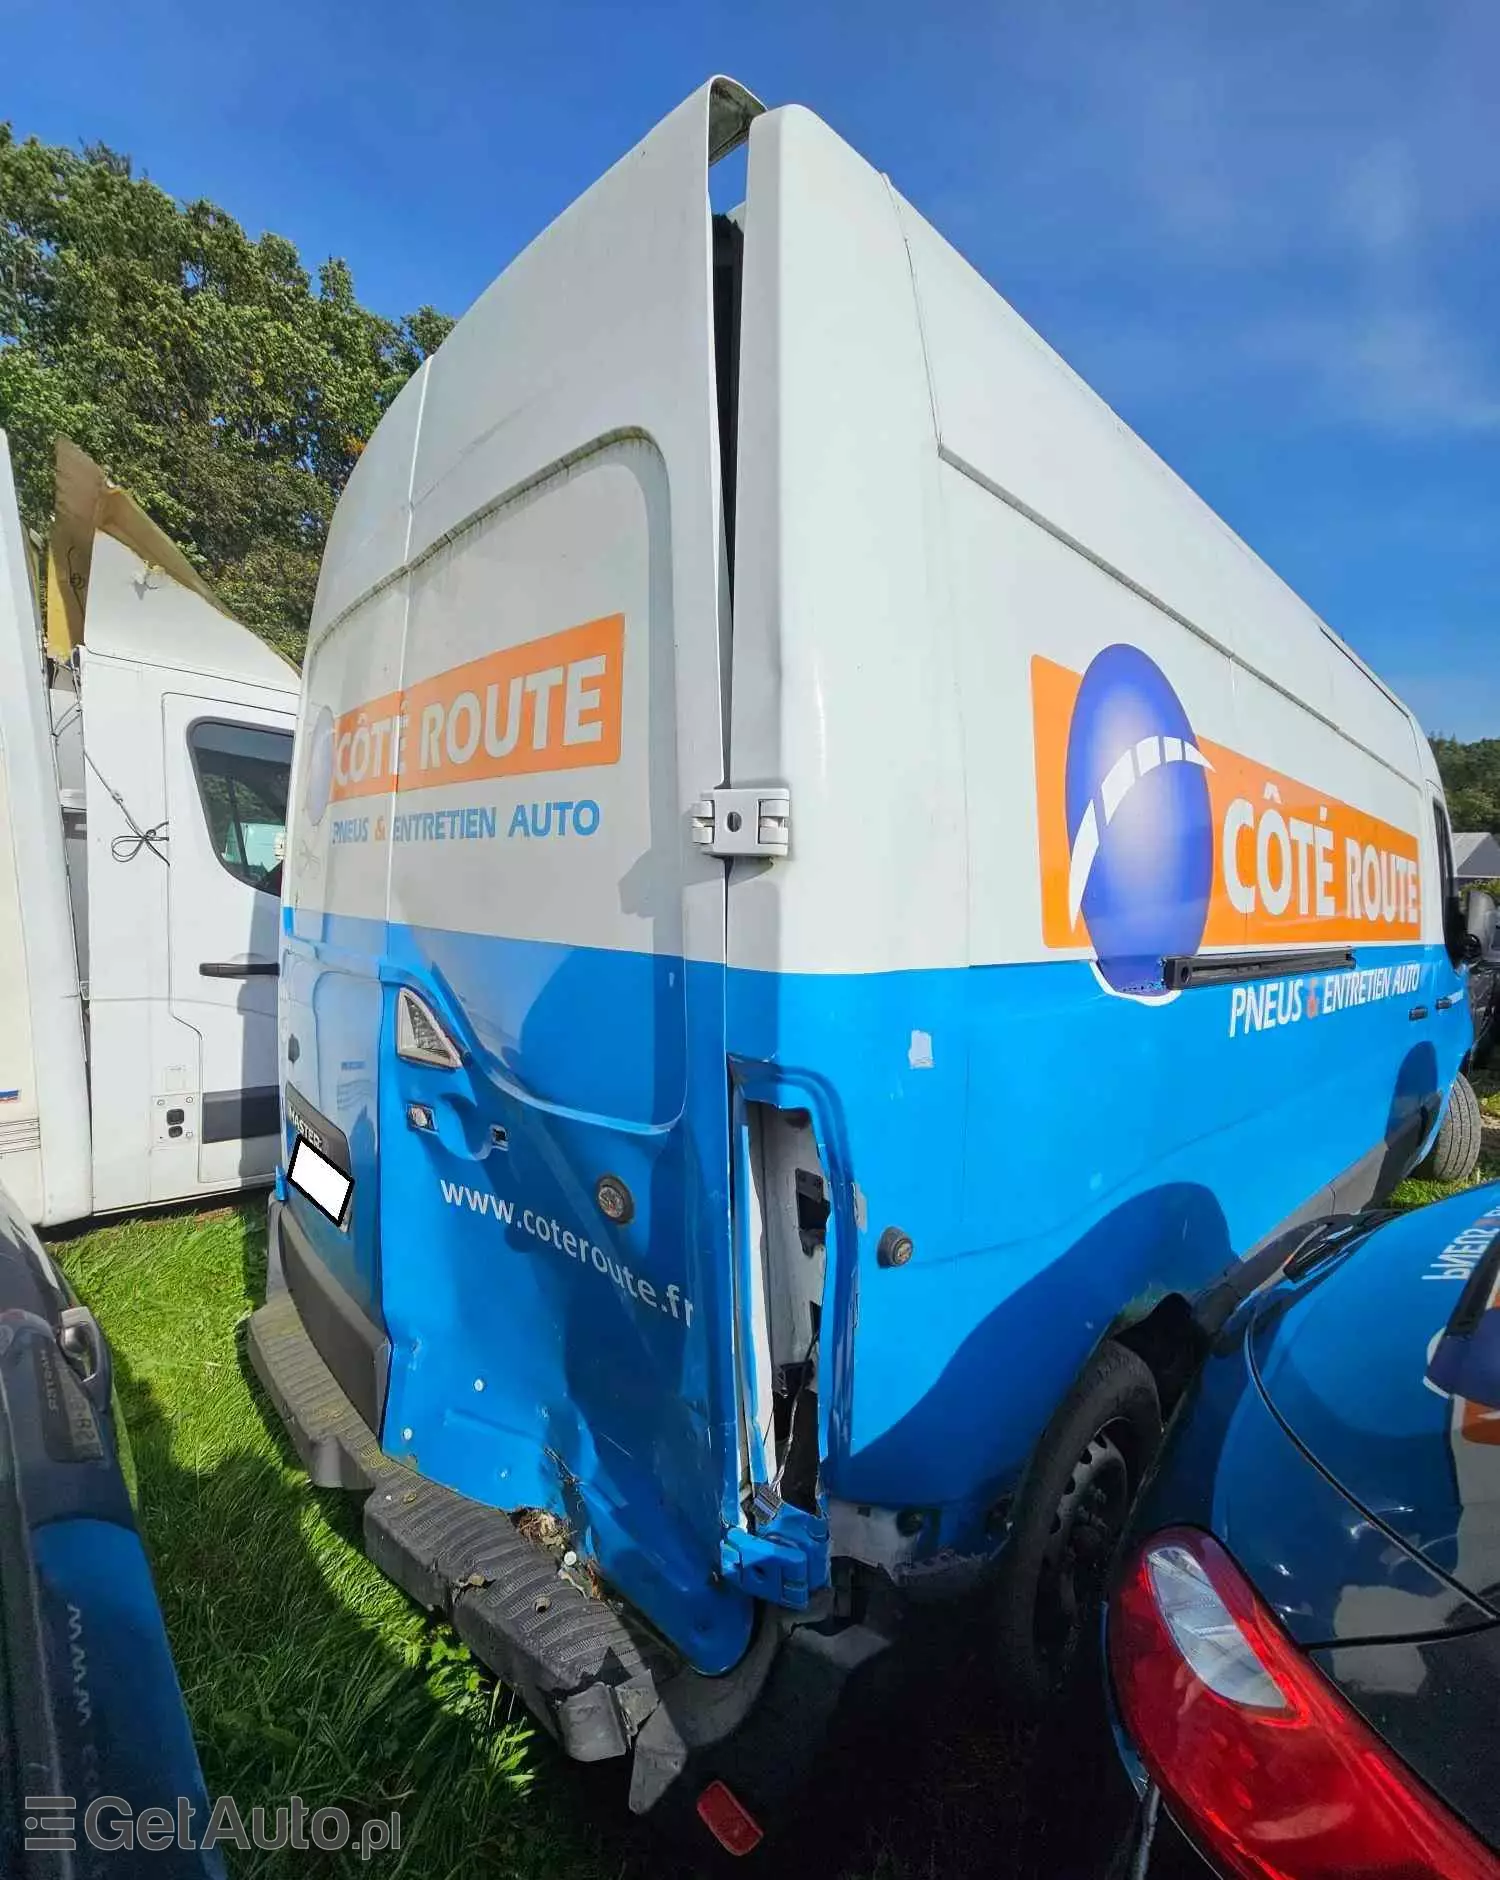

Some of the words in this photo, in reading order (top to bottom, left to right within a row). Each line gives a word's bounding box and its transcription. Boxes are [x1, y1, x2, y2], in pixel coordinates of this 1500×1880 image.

[420, 654, 607, 771] ROUTE
[332, 816, 369, 845] PNEUS
[374, 815, 387, 842] &
[393, 806, 497, 843] ENTRETIEN
[508, 800, 600, 838] AUTO
[1223, 781, 1336, 916] CÔTÉ
[1345, 836, 1419, 924] ROUTE
[1229, 978, 1305, 1038] PNEUS
[1322, 966, 1393, 1015] ENTRETIEN
[1391, 961, 1422, 1001] AUTO
[440, 1178, 694, 1329] www.coteroute.fr
